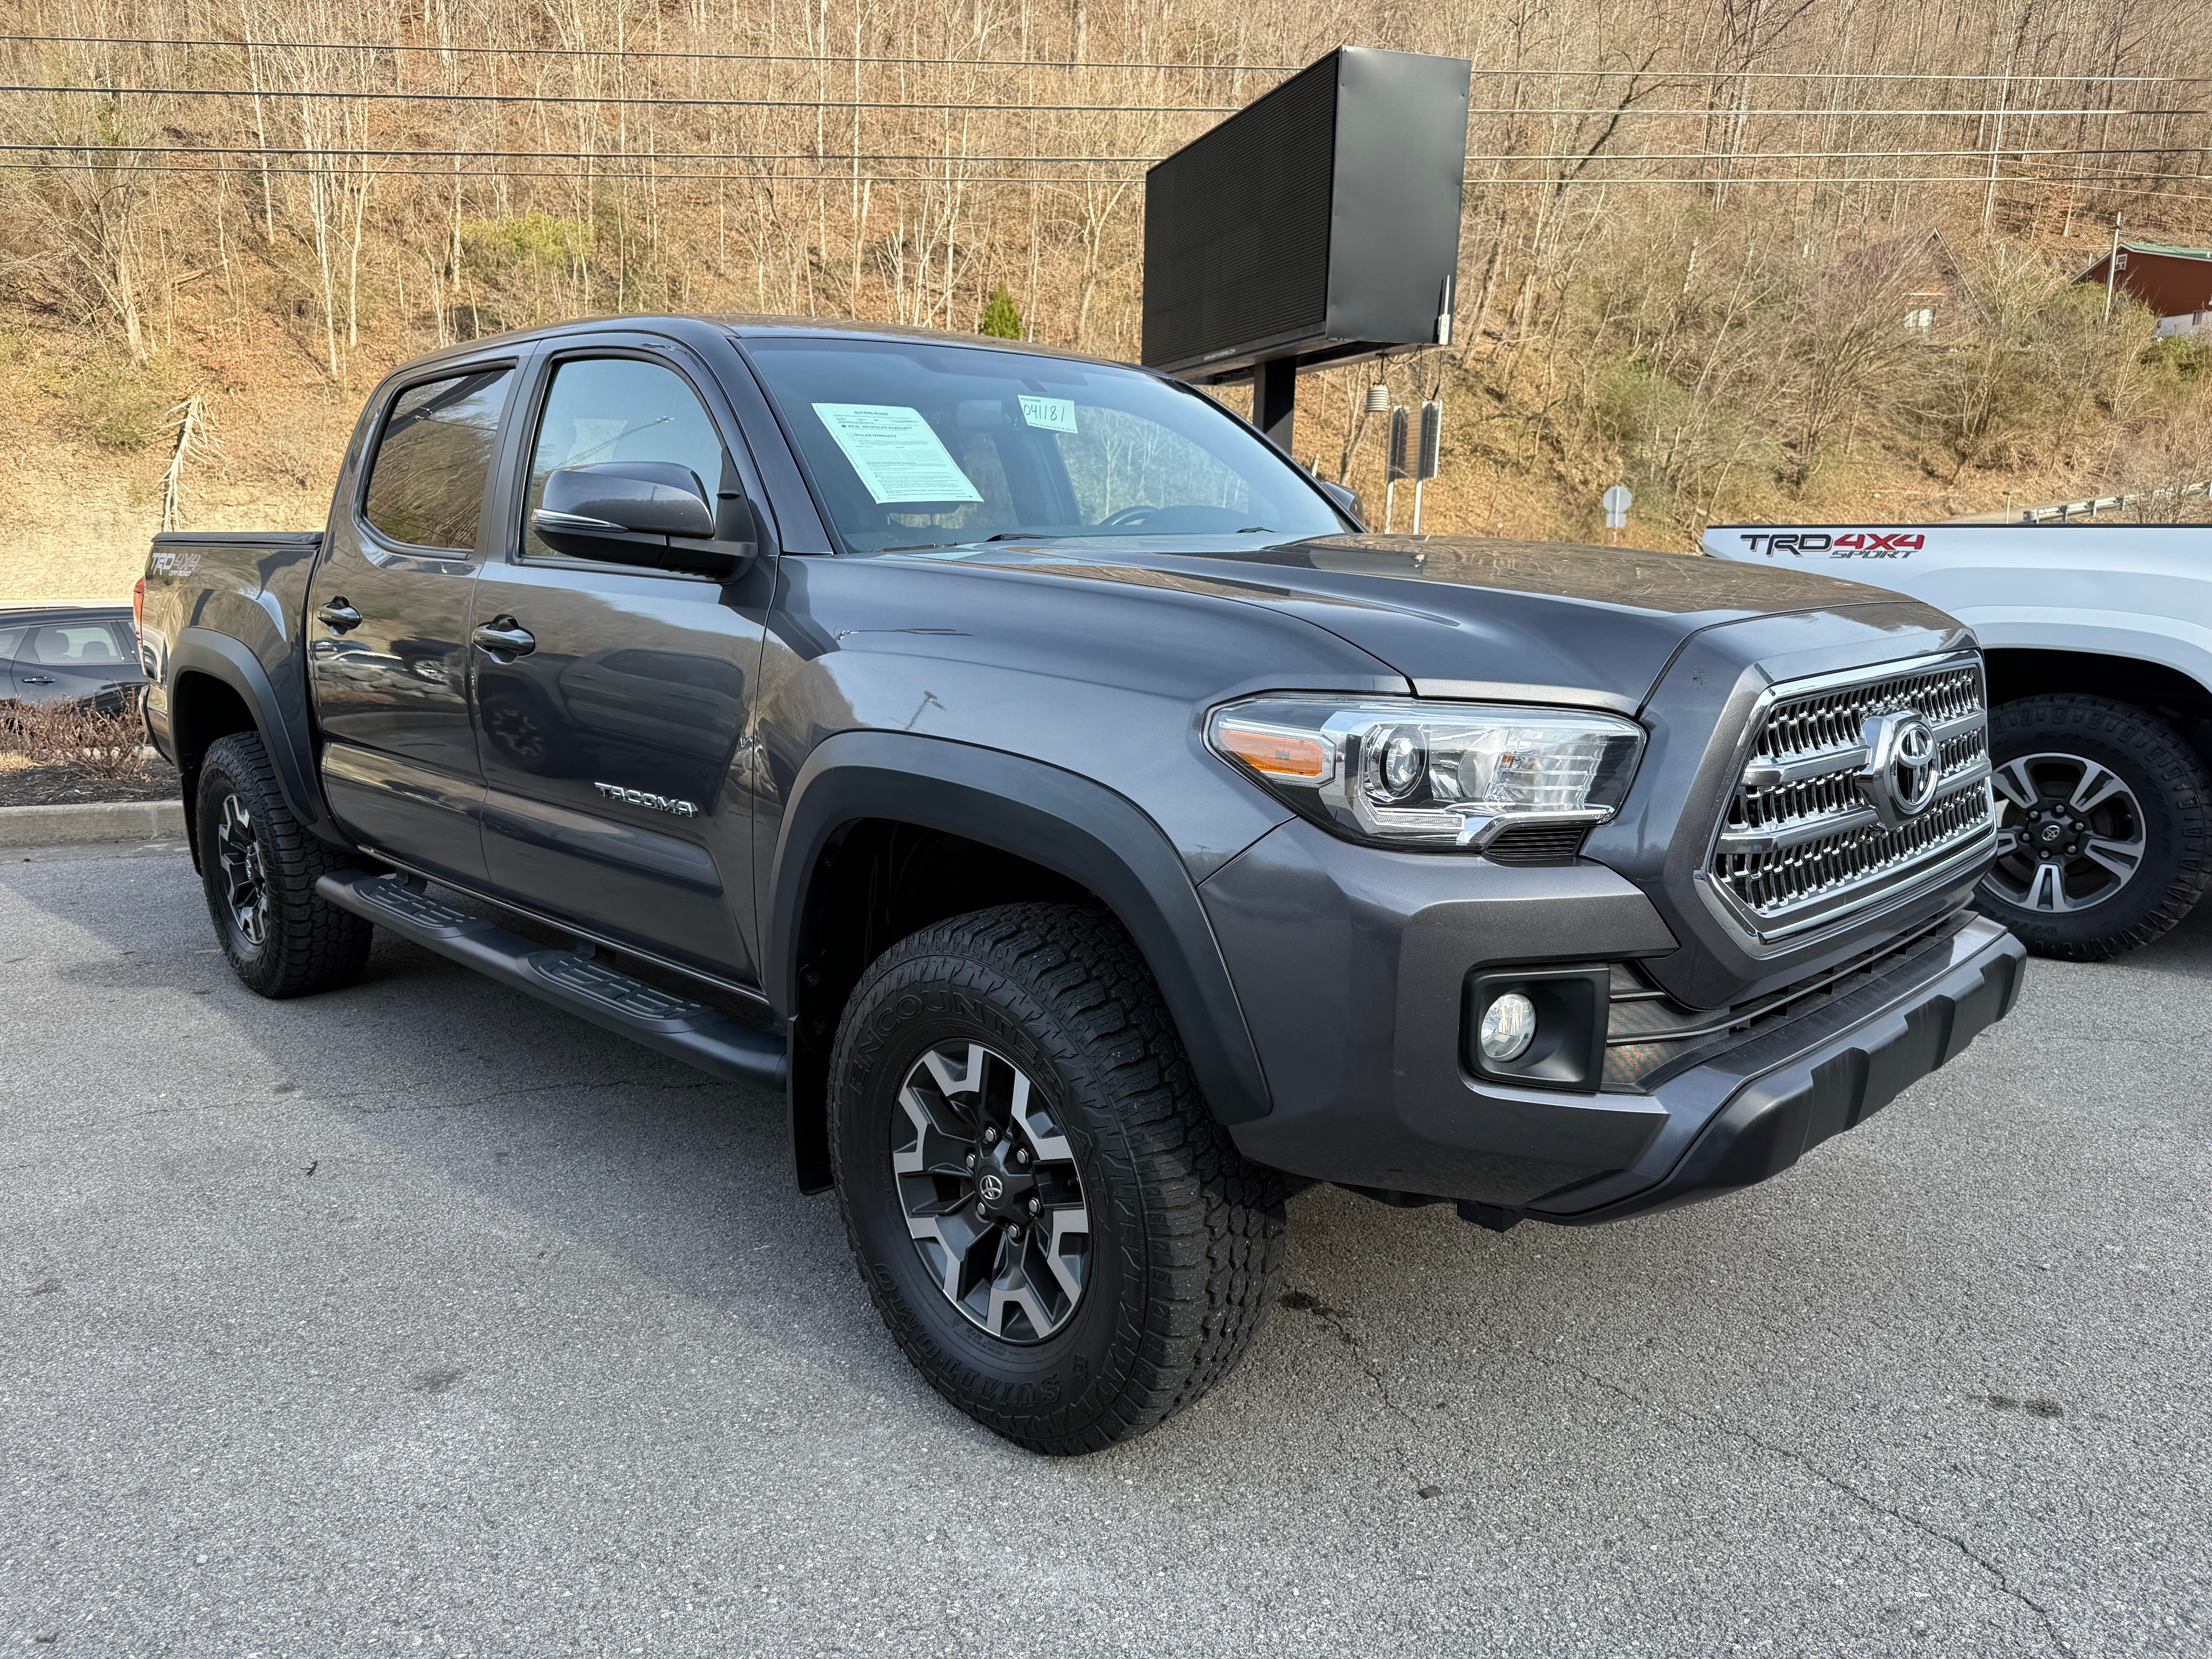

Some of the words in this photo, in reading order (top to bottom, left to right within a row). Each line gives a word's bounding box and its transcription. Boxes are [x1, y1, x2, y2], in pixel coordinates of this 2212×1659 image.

[1024, 404, 1065, 422] 041181
[1740, 534, 1834, 558] TRD
[1834, 534, 1925, 551] 4X4
[1829, 550, 1919, 559] SPORT
[151, 553, 176, 575] TRD
[594, 781, 699, 818] TACOMA
[849, 989, 1065, 1097] ENCOUNTER
[874, 1263, 1061, 1408] SUMITOMO
